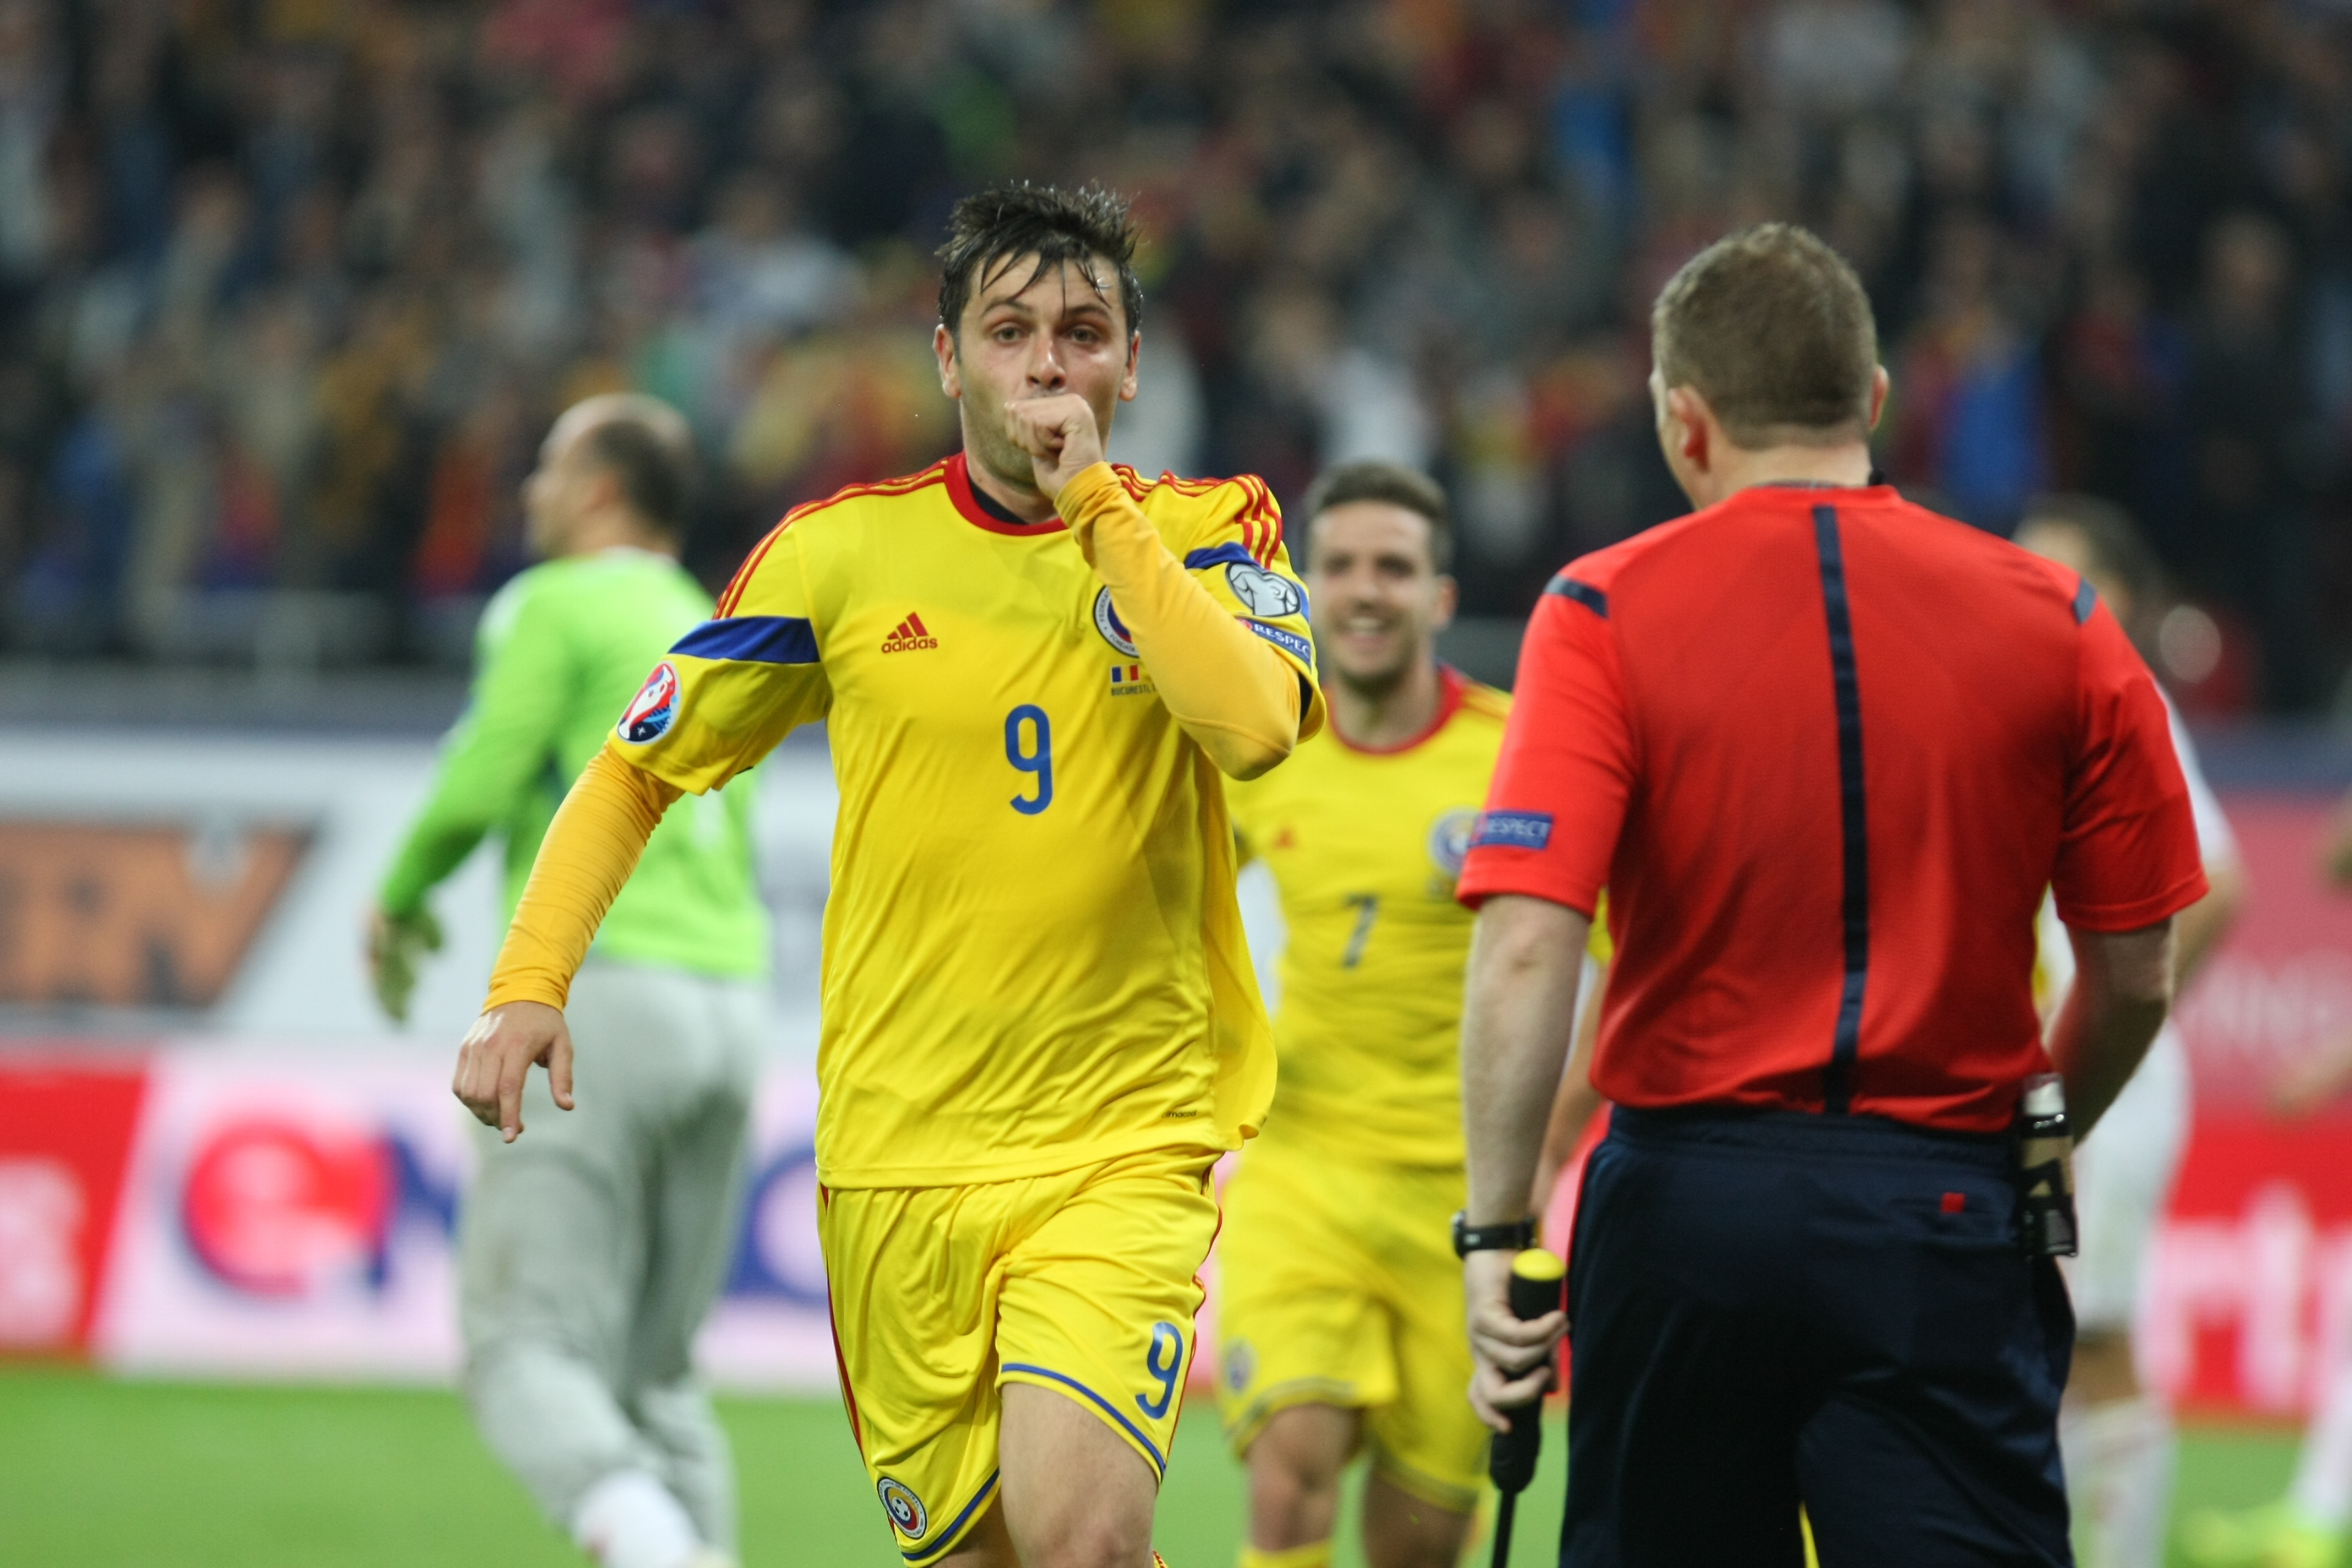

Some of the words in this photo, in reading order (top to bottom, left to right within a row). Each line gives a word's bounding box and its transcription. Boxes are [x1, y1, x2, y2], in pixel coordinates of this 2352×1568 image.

[881, 637, 938, 653] adidas
[1004, 704, 1054, 815] 9
[1341, 892, 1379, 969] 7
[1134, 1321, 1183, 1420] 9
